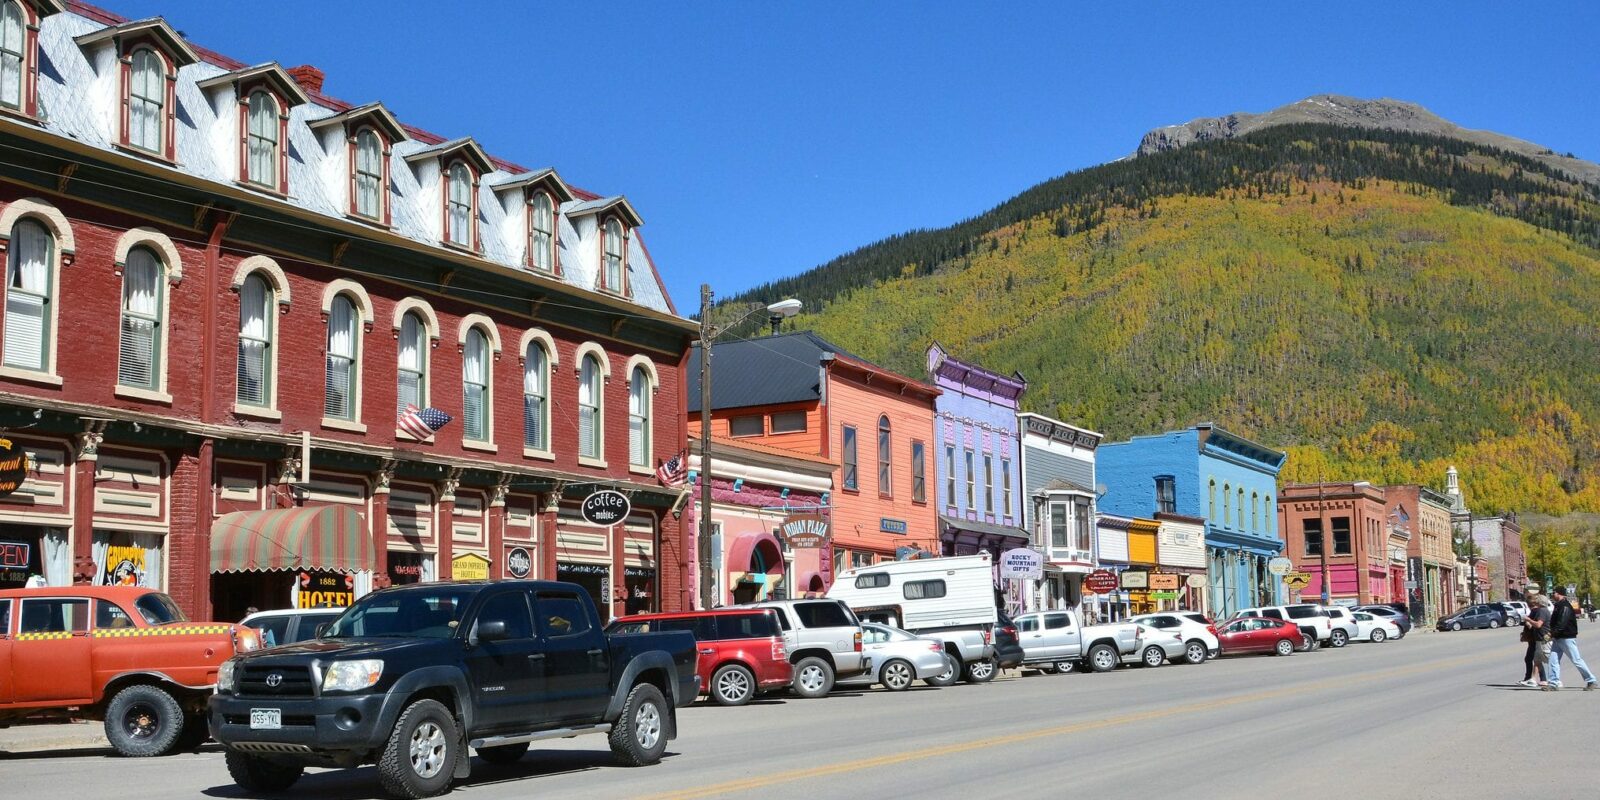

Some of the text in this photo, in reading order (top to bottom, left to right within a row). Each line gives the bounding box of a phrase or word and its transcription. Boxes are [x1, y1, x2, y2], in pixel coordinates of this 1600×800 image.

[587, 493, 623, 509] coffee
[783, 520, 828, 538] INDIAN PLAZA
[452, 561, 468, 569] GRAND
[460, 570, 476, 578] HOTEL
